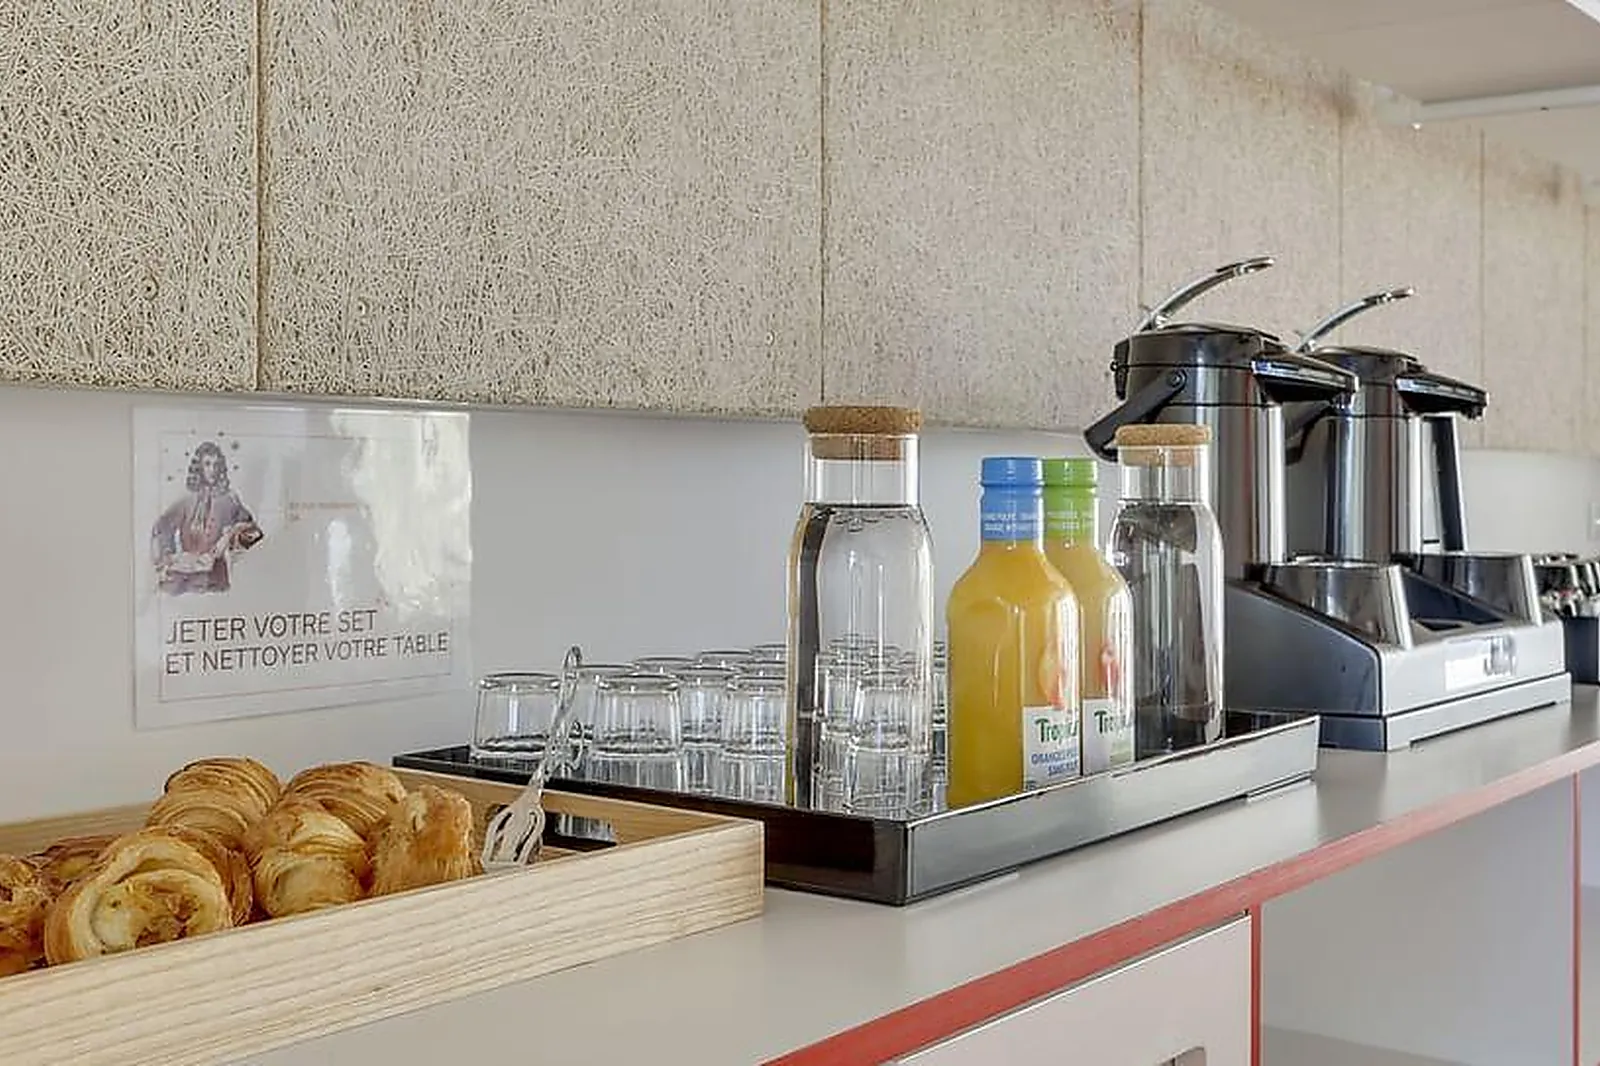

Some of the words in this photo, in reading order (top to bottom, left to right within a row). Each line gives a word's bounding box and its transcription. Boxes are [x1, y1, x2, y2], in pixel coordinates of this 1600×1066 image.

[166, 618, 246, 644] JETER
[254, 612, 331, 638] VOTRE
[338, 610, 377, 632] SET
[166, 652, 194, 675] ET
[202, 644, 318, 671] NETTOYER
[324, 638, 387, 661] VOTRE
[393, 633, 448, 653] TABLE
